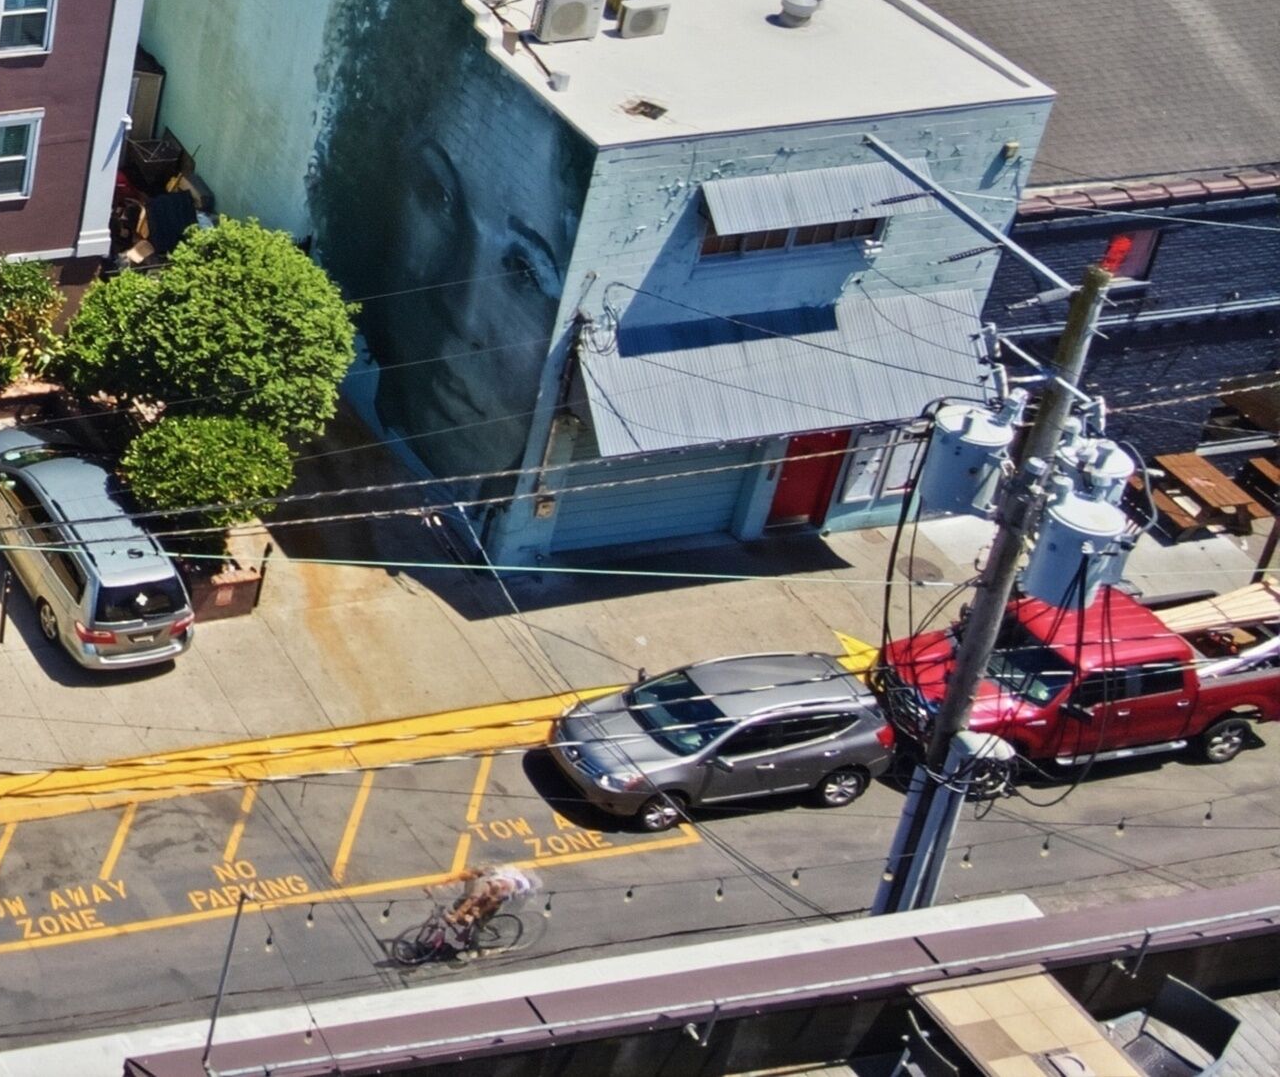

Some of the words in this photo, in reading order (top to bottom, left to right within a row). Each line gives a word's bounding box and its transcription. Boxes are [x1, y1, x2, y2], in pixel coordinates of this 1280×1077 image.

[467, 817, 533, 842] TOW
[524, 829, 613, 858] ZONE
[211, 860, 257, 883] NO
[50, 879, 127, 911] AWAY
[187, 875, 309, 911] PARKING
[16, 908, 105, 939] ZONE
